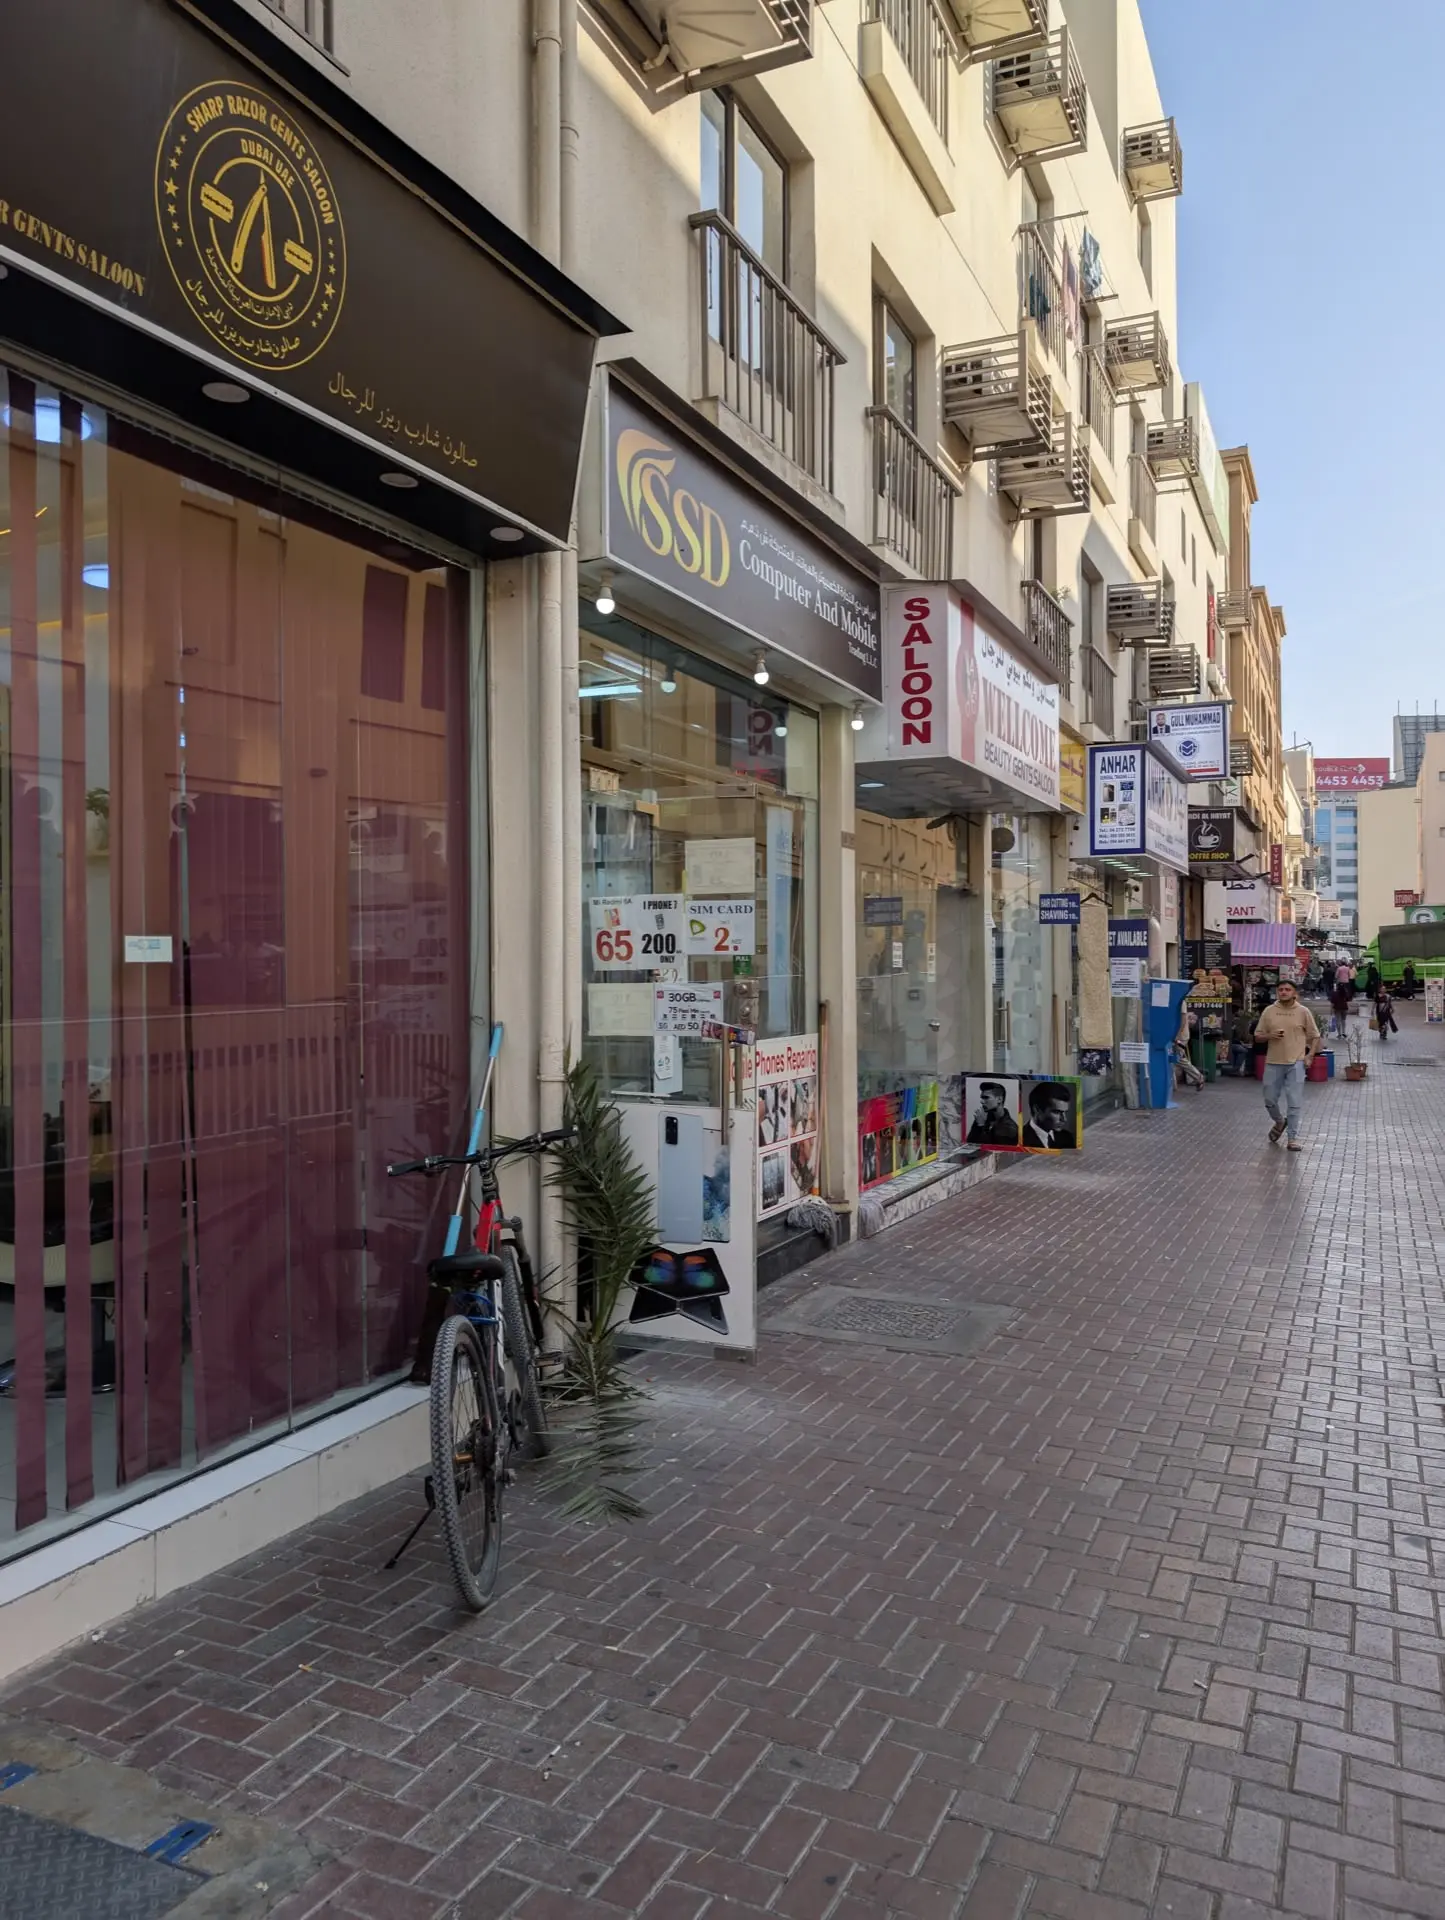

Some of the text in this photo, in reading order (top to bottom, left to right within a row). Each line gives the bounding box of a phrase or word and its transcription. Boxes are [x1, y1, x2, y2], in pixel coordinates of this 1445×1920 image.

[186, 95, 224, 133] SHARP
[226, 94, 268, 124] RAZOR
[303, 157, 335, 225] SALOON
[240, 138, 296, 189] DUBAI UAE
[13, 208, 76, 260] GENTS
[76, 243, 146, 297] SALOON
[328, 372, 478, 467] صالون شارب ريزر للرجال
[640, 467, 730, 587] SSD
[739, 539, 877, 651] Computer And Mobile
[901, 597, 932, 745] SALOON
[984, 738, 1013, 773] BEAUTY
[1012, 756, 1034, 785] GENTS
[1033, 769, 1056, 797] SALOON
[1100, 755, 1136, 774] ANHAR
[1316, 775, 1384, 787] 4453 4453
[1188, 852, 1210, 860] OFFEE
[647, 901, 672, 910] PHONE
[689, 905, 753, 914] SIM CARD
[1040, 910, 1069, 920] SHAVING
[596, 930, 633, 961] 65
[641, 933, 676, 954] 200
[1117, 930, 1148, 946] AVAILABLE
[660, 955, 675, 963] ONLY
[668, 992, 697, 1002] 30GB
[687, 1022, 699, 1030] 50
[755, 1050, 785, 1076] Phones
[786, 1046, 816, 1075] Repairing
